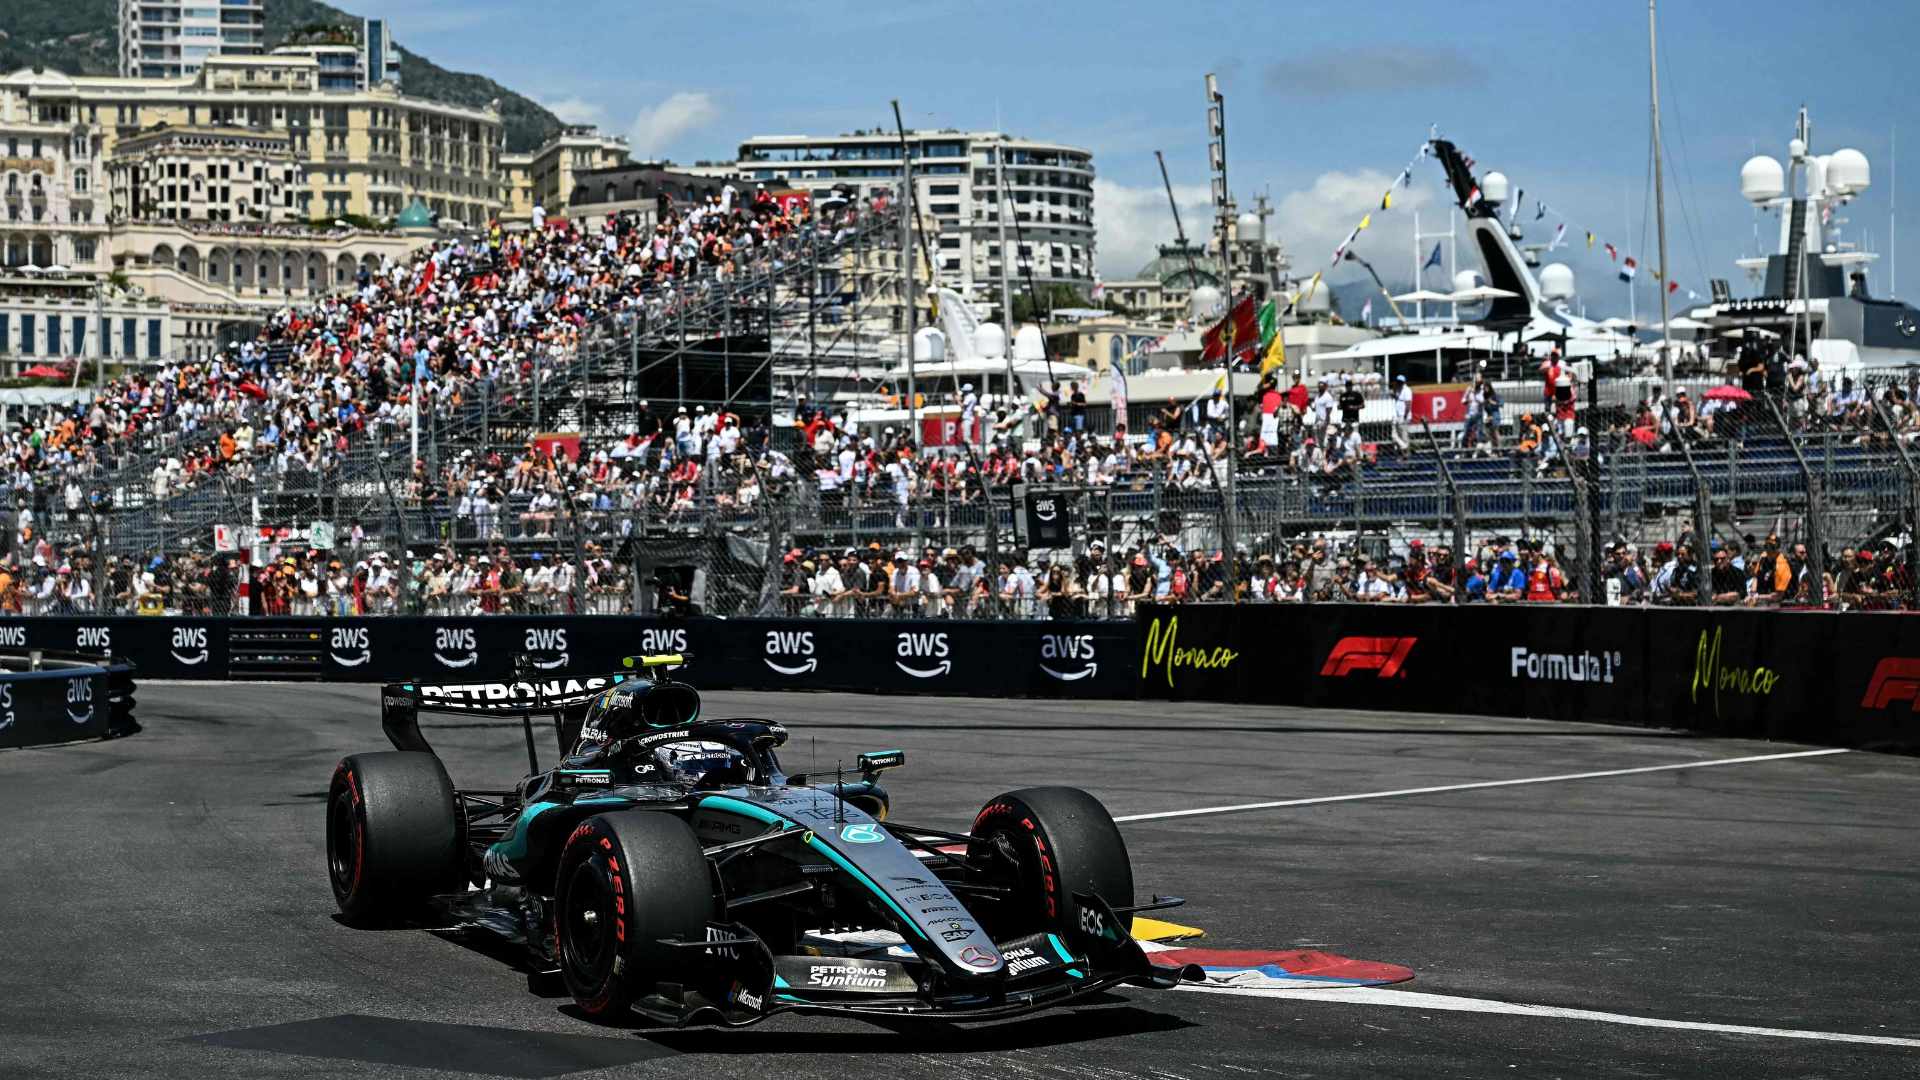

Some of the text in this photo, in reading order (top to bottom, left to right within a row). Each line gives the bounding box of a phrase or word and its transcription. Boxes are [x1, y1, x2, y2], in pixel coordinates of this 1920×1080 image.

[1432, 396, 1447, 420] P
[944, 422, 956, 442] P
[1036, 500, 1056, 511] aws
[77, 627, 110, 646] aws
[172, 627, 207, 648] aws
[331, 628, 369, 648] aws
[436, 628, 477, 649] aws
[525, 628, 568, 650] aws
[642, 629, 687, 651] aws
[766, 631, 815, 654] aws
[898, 633, 949, 657] aws
[1041, 634, 1094, 659] aws
[1142, 616, 1238, 688] Monaco
[1320, 637, 1417, 678] F1
[1511, 647, 1600, 682] Formula
[1693, 625, 1780, 719] Monaco
[67, 678, 92, 703] aws
[420, 678, 606, 709] PETRONAS
[640, 731, 689, 745] CROWDSTRIKE
[872, 757, 897, 765] PETRONAS
[600, 837, 612, 850] P
[608, 856, 624, 942] ZERO
[705, 926, 740, 960] IWC
[1002, 948, 1034, 961] ONAS
[807, 974, 886, 988] Syntium
[810, 966, 887, 977] PETRONAS
